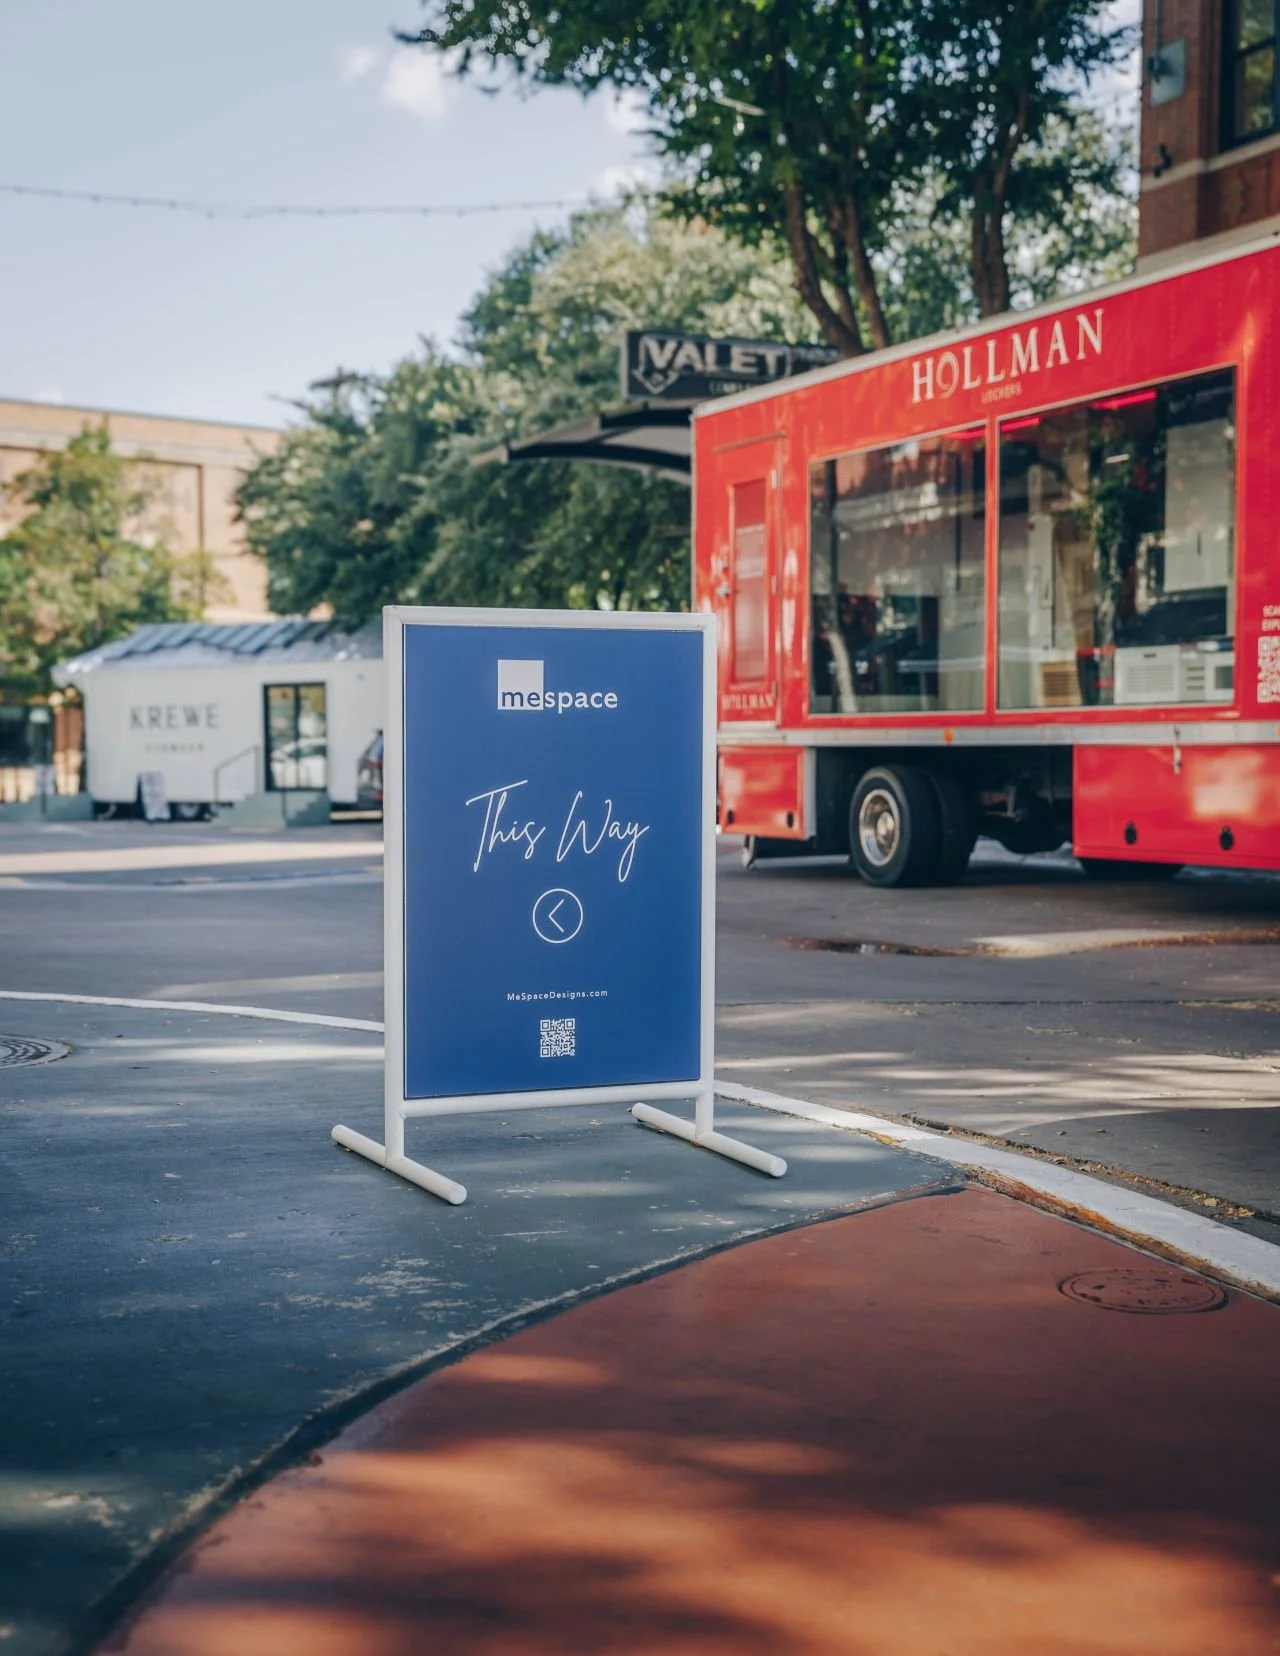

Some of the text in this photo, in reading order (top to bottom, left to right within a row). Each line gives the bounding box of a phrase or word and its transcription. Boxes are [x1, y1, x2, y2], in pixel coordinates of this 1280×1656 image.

[645, 337, 784, 377] VALET
[911, 307, 1104, 403] HOLLMAN
[129, 704, 220, 730] KREWE
[501, 691, 618, 714] mespace
[465, 779, 650, 882] This Way
[507, 990, 608, 1002] MeSpaceDesigns.com
